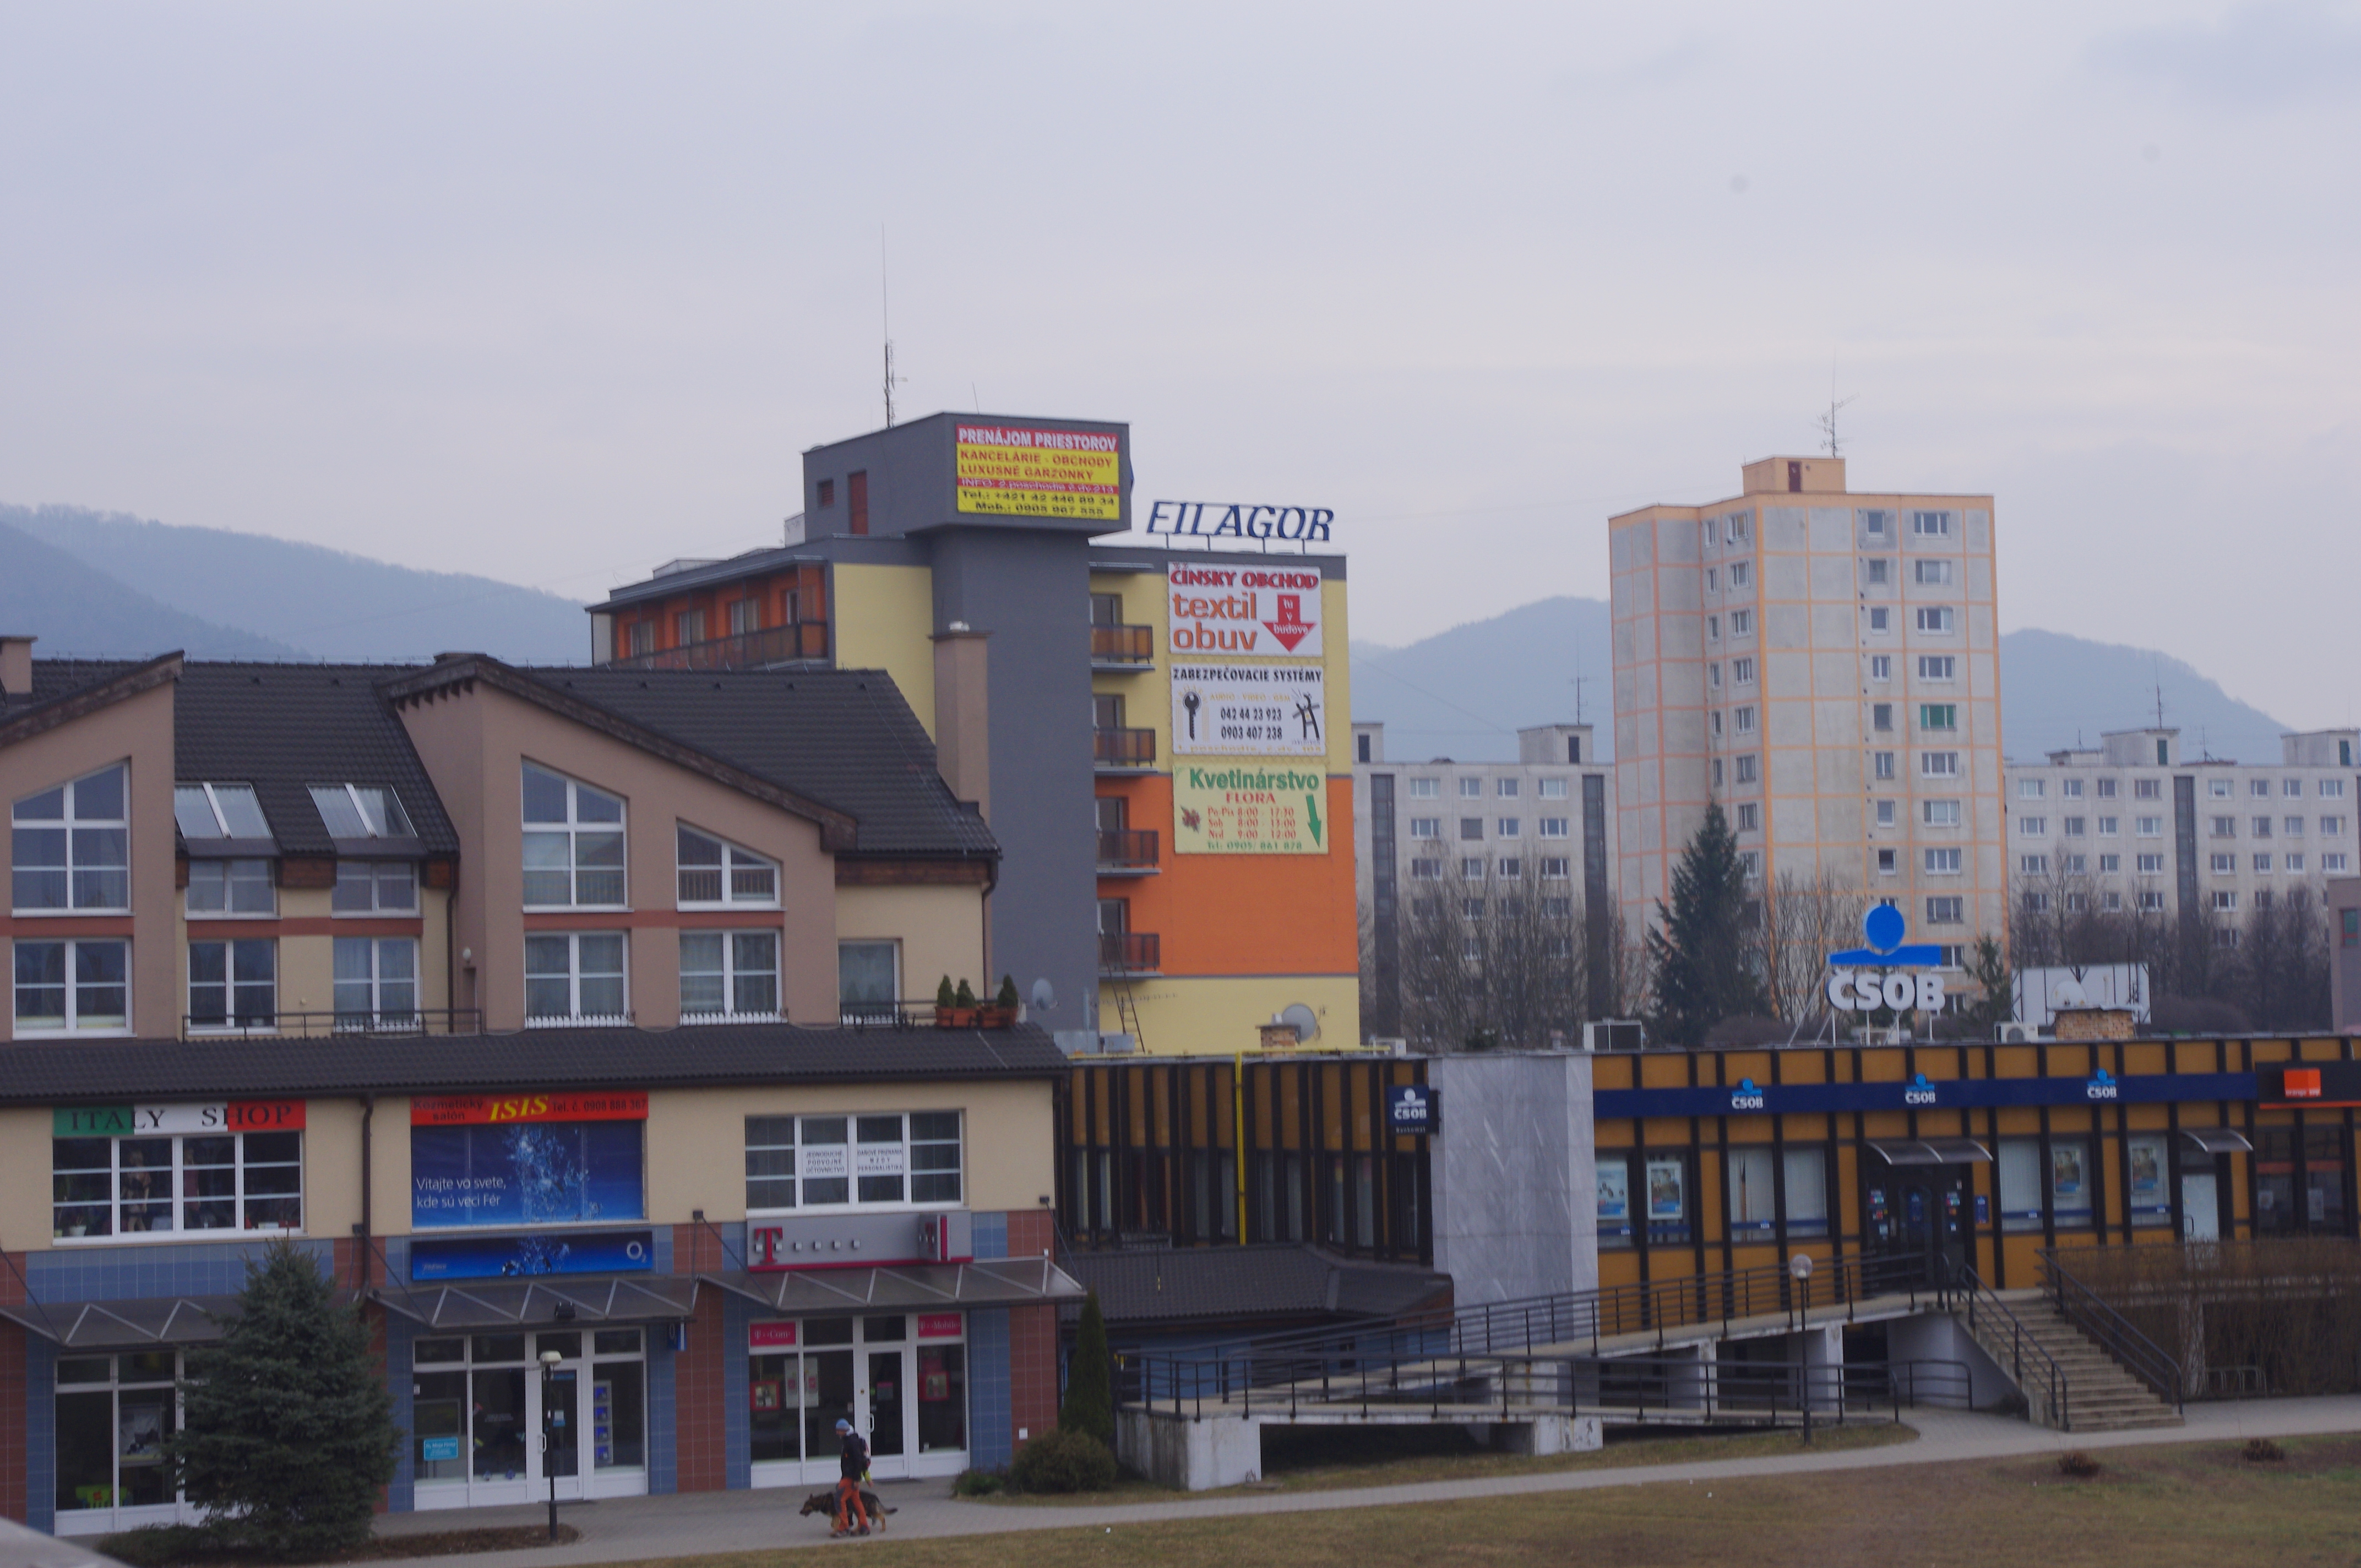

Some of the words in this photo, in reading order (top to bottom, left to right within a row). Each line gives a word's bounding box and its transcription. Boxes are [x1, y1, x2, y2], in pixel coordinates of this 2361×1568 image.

[959, 427, 1031, 447] PRENÁJOM
[1035, 433, 1117, 452] PRIESTOROV
[960, 449, 1041, 465] KANCELÁRIE
[1052, 454, 1112, 468] OBCHODY
[960, 465, 1020, 477] LUXUSNÉ
[962, 478, 995, 488] INFO:
[995, 492, 1025, 500] +421
[1031, 493, 1047, 502] 42
[1146, 501, 1335, 542] FILAGOR
[1241, 571, 1319, 591] OBCHOD
[1172, 591, 1257, 620] textil
[1283, 598, 1293, 609] tu
[1286, 612, 1292, 622] v
[1173, 621, 1258, 651] obuv
[1173, 665, 1270, 682] ZABEZPEČOVACIE
[1274, 667, 1322, 683] SYSTÉMY
[1221, 707, 1237, 721] 042
[1240, 707, 1250, 721] 44
[1254, 707, 1263, 721] 23
[1266, 708, 1282, 721] 923
[1221, 727, 1244, 740] 0903
[1247, 727, 1263, 740] 407
[1266, 727, 1282, 740] 238
[1190, 767, 1319, 791] Kvetinárstvo
[1226, 792, 1276, 804] FLORA
[1238, 806, 1258, 817] 8:00
[1238, 818, 1259, 828] 8:00
[1825, 967, 1946, 1011] ČSOB
[489, 1095, 548, 1121] ISIS
[71, 1108, 165, 1131] ITALY
[202, 1104, 292, 1128] SHOP
[416, 1176, 453, 1193] Vitajte
[456, 1178, 471, 1189] vo
[474, 1176, 507, 1190] svete,
[417, 1194, 438, 1208] kde
[442, 1195, 455, 1208] sú
[458, 1193, 480, 1207] veci
[483, 1193, 501, 1207] Fér
[754, 1226, 784, 1264] T
